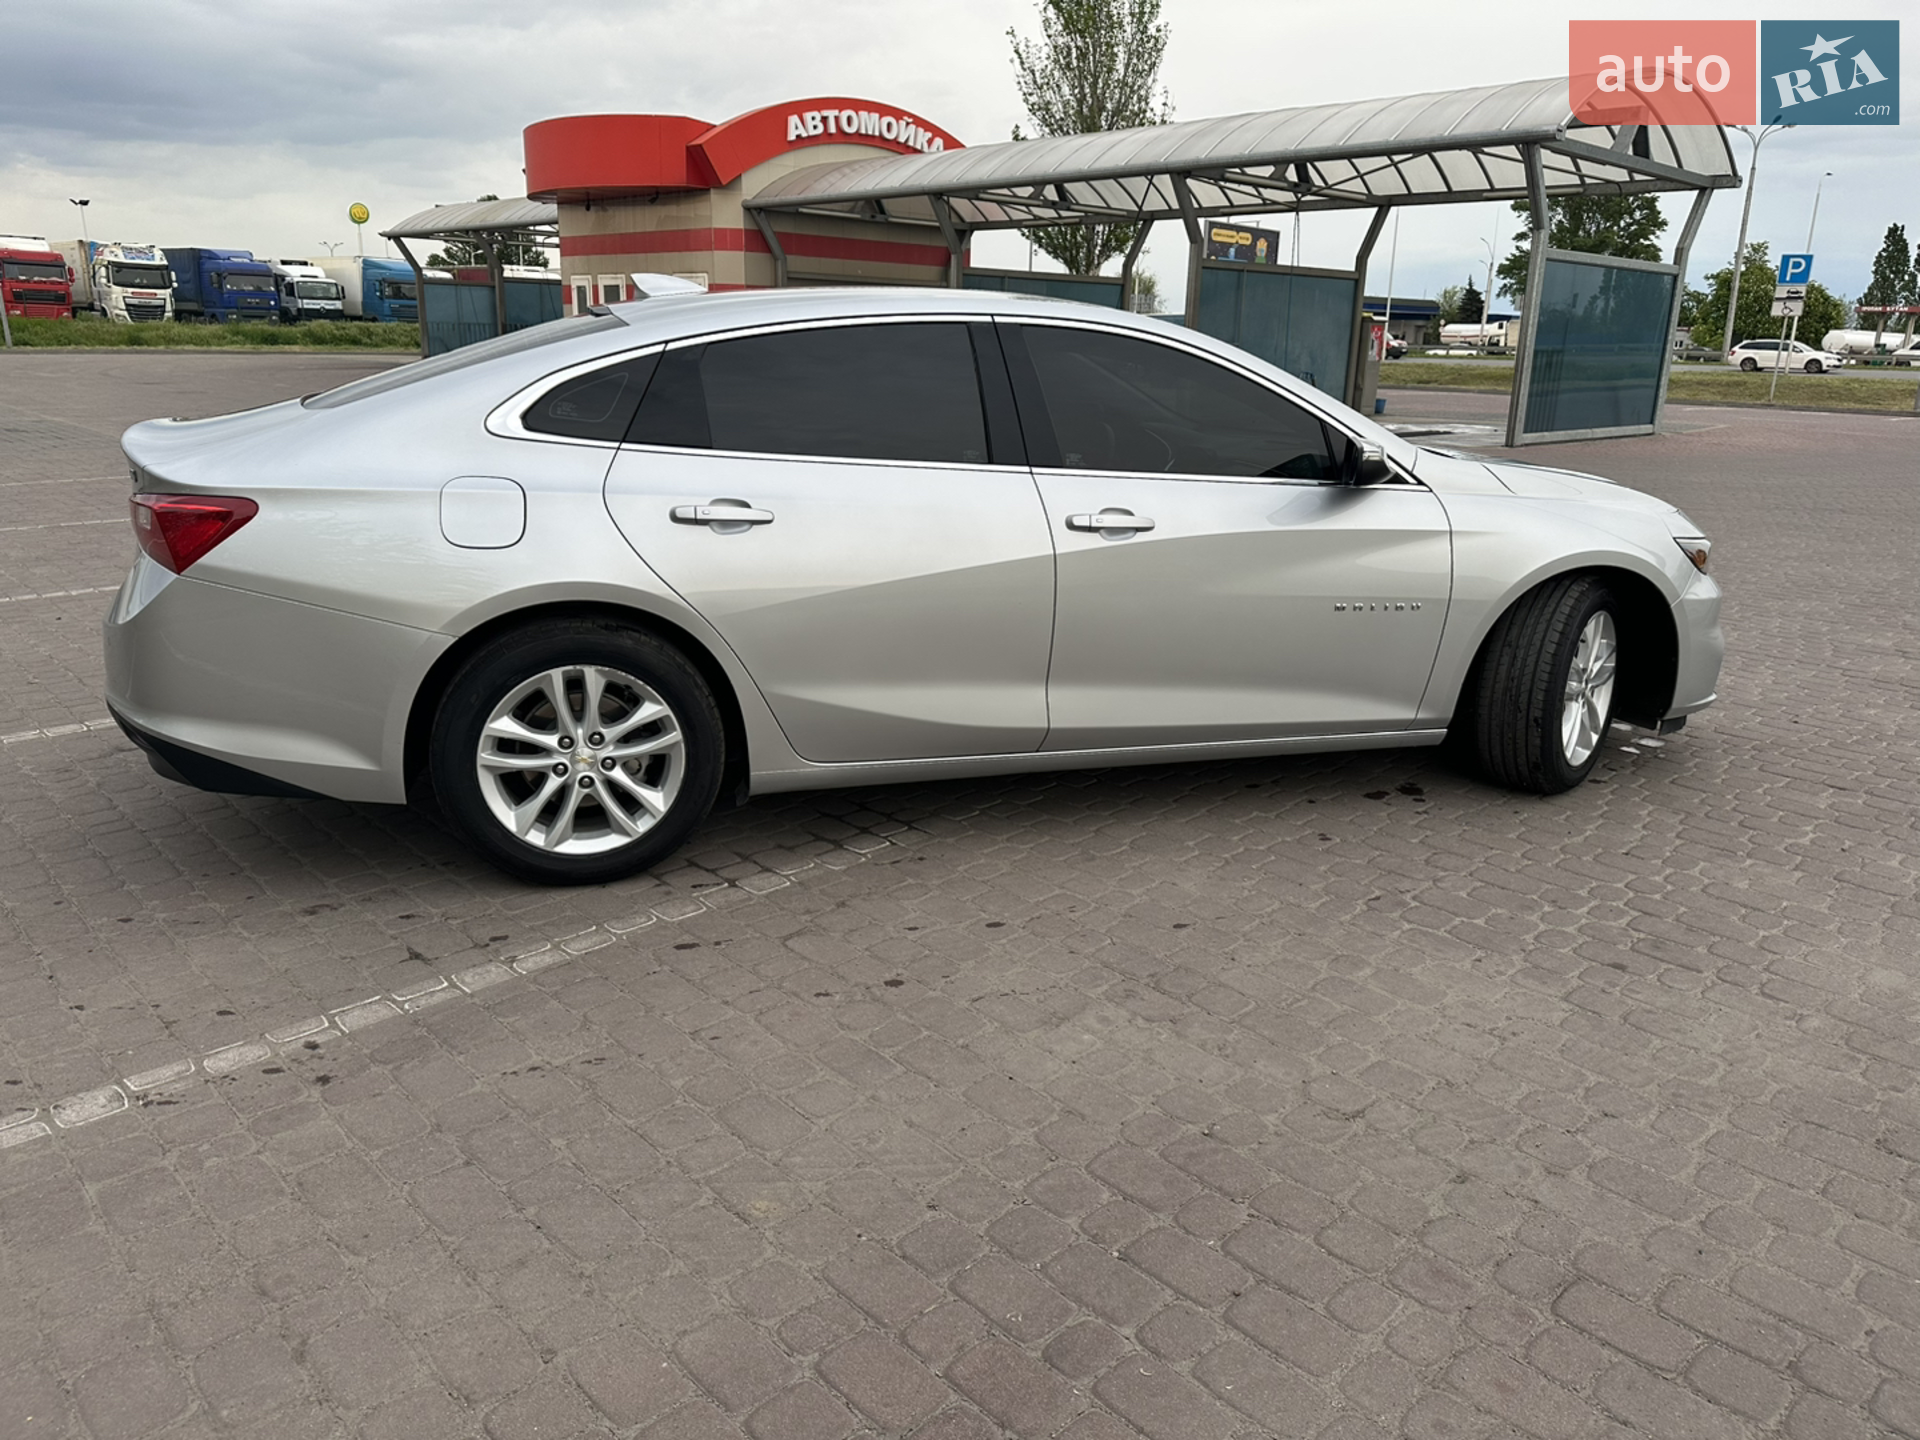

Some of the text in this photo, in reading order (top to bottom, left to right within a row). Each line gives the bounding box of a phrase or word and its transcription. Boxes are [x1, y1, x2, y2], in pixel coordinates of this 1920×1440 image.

[786, 109, 944, 153] АВТОМОЙКА
[1785, 257, 1806, 282] P
[1334, 602, 1422, 612] MALIBU
